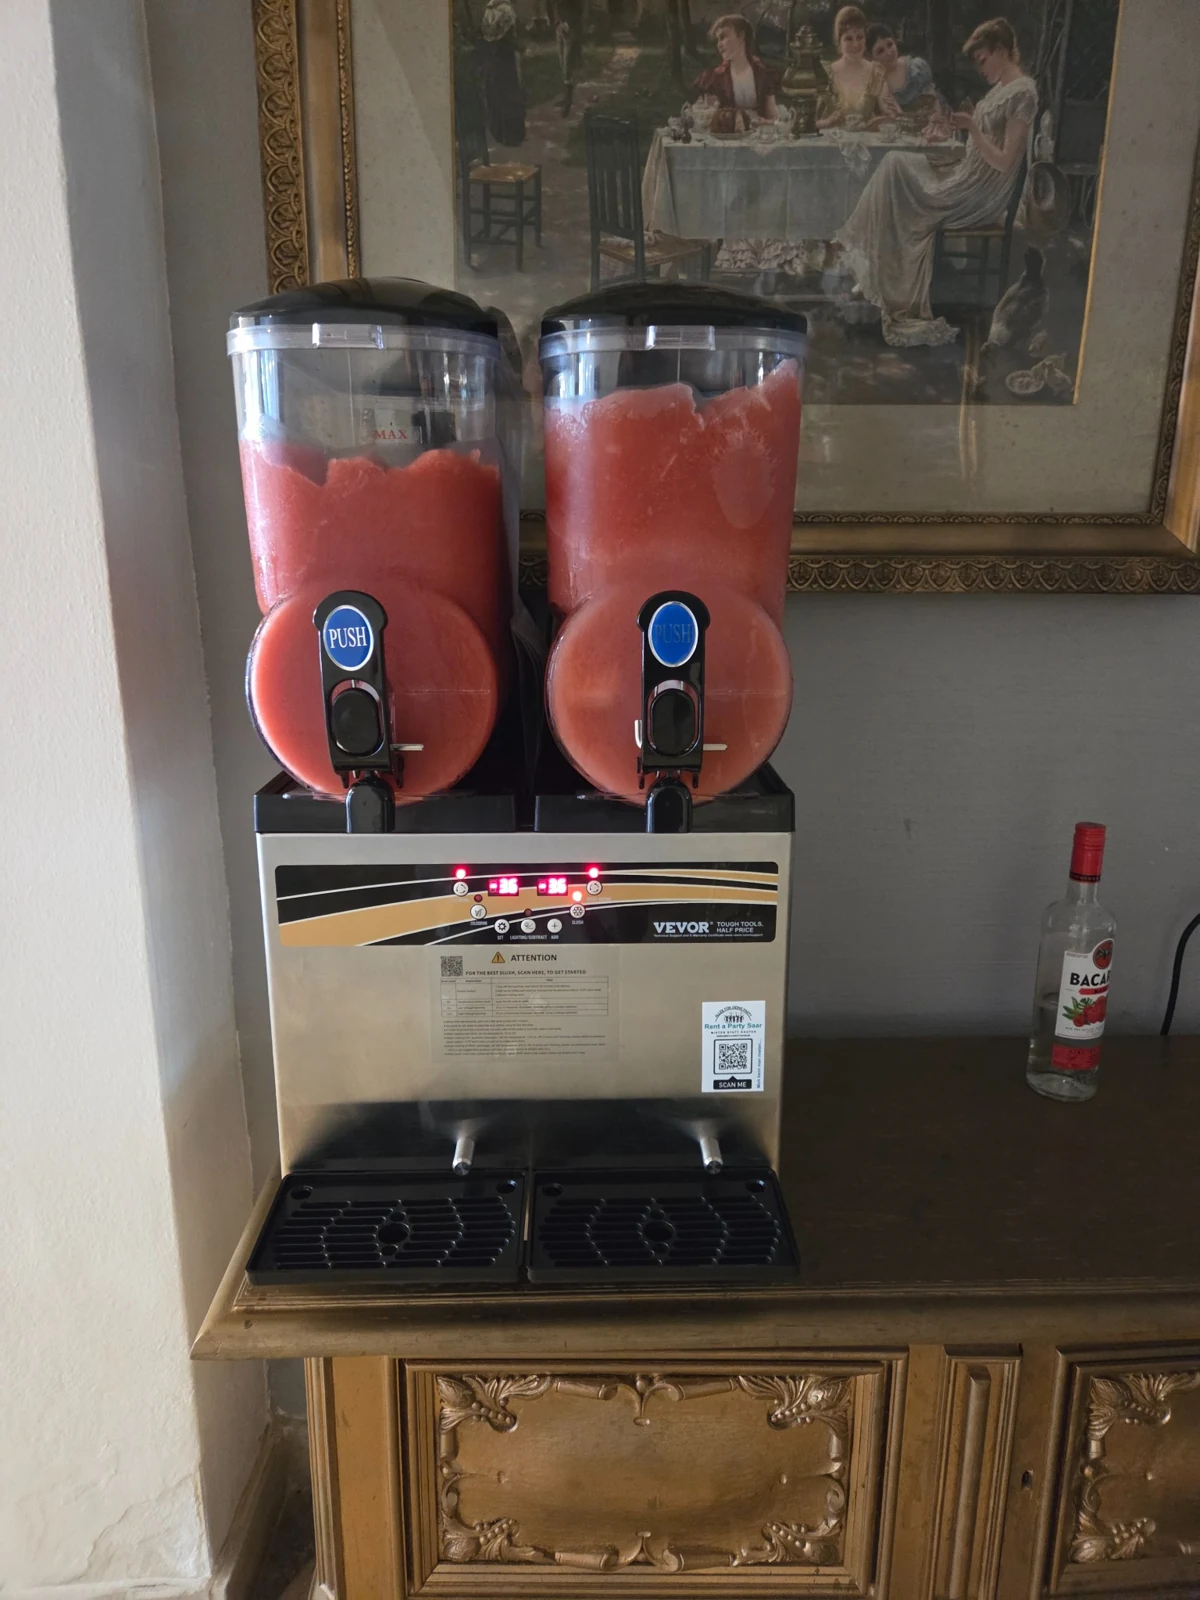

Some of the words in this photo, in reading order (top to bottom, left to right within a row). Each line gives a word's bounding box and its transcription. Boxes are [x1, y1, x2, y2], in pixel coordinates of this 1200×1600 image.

[375, 428, 408, 440] MAX
[328, 626, 368, 649] PUSH
[654, 623, 692, 644] PUSH
[653, 921, 710, 934] VEVOR
[510, 954, 558, 962] ATTENTION
